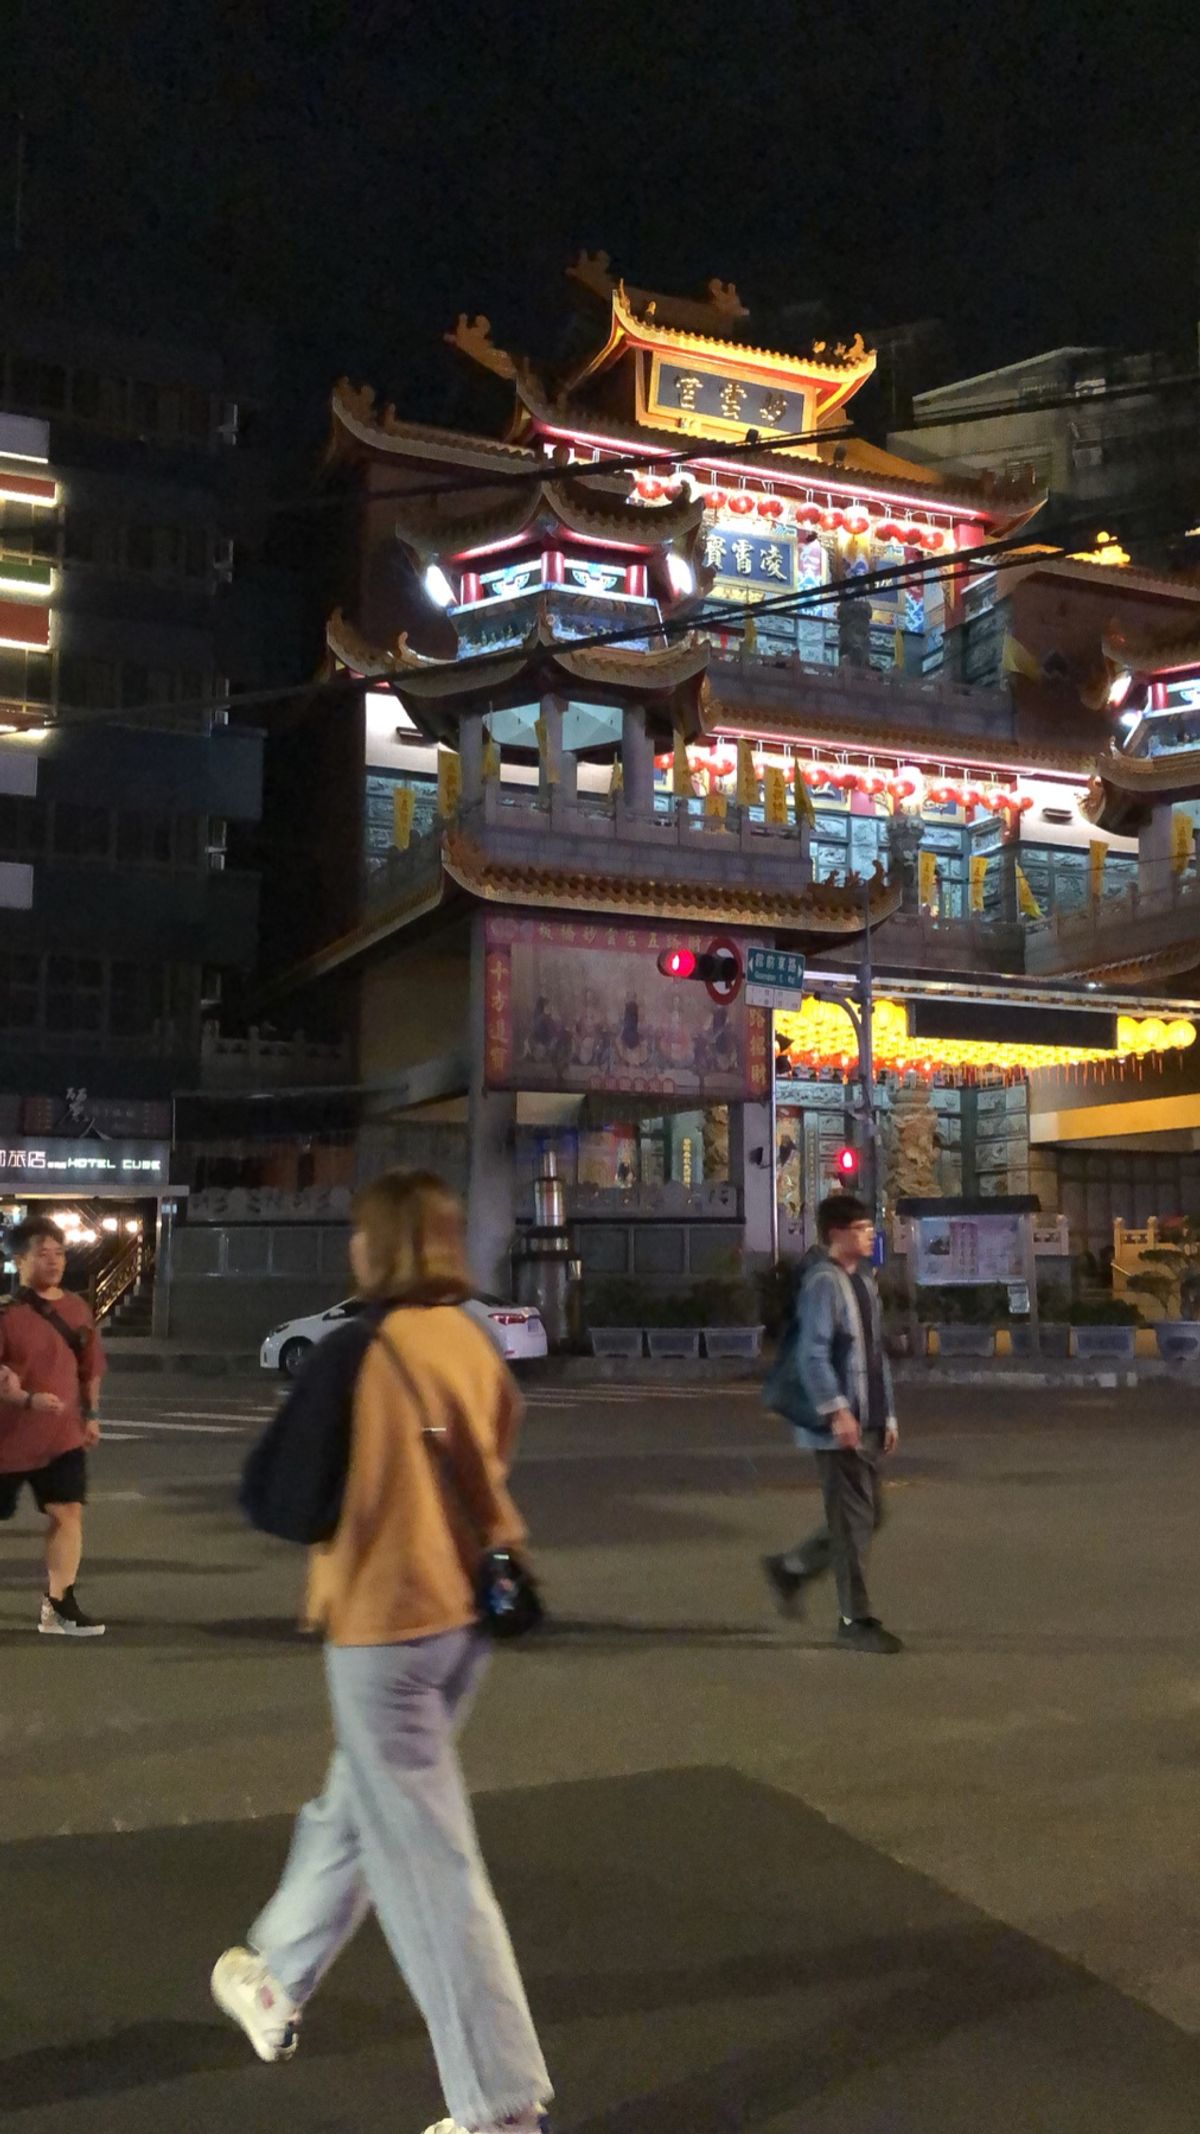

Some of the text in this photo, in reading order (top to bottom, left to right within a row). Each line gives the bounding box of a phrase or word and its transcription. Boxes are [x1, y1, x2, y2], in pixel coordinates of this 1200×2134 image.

[538, 922, 720, 952] 板橋妙雲宮五路財
[67, 1157, 116, 1169] HOTEL
[122, 1159, 161, 1170] CUBE
